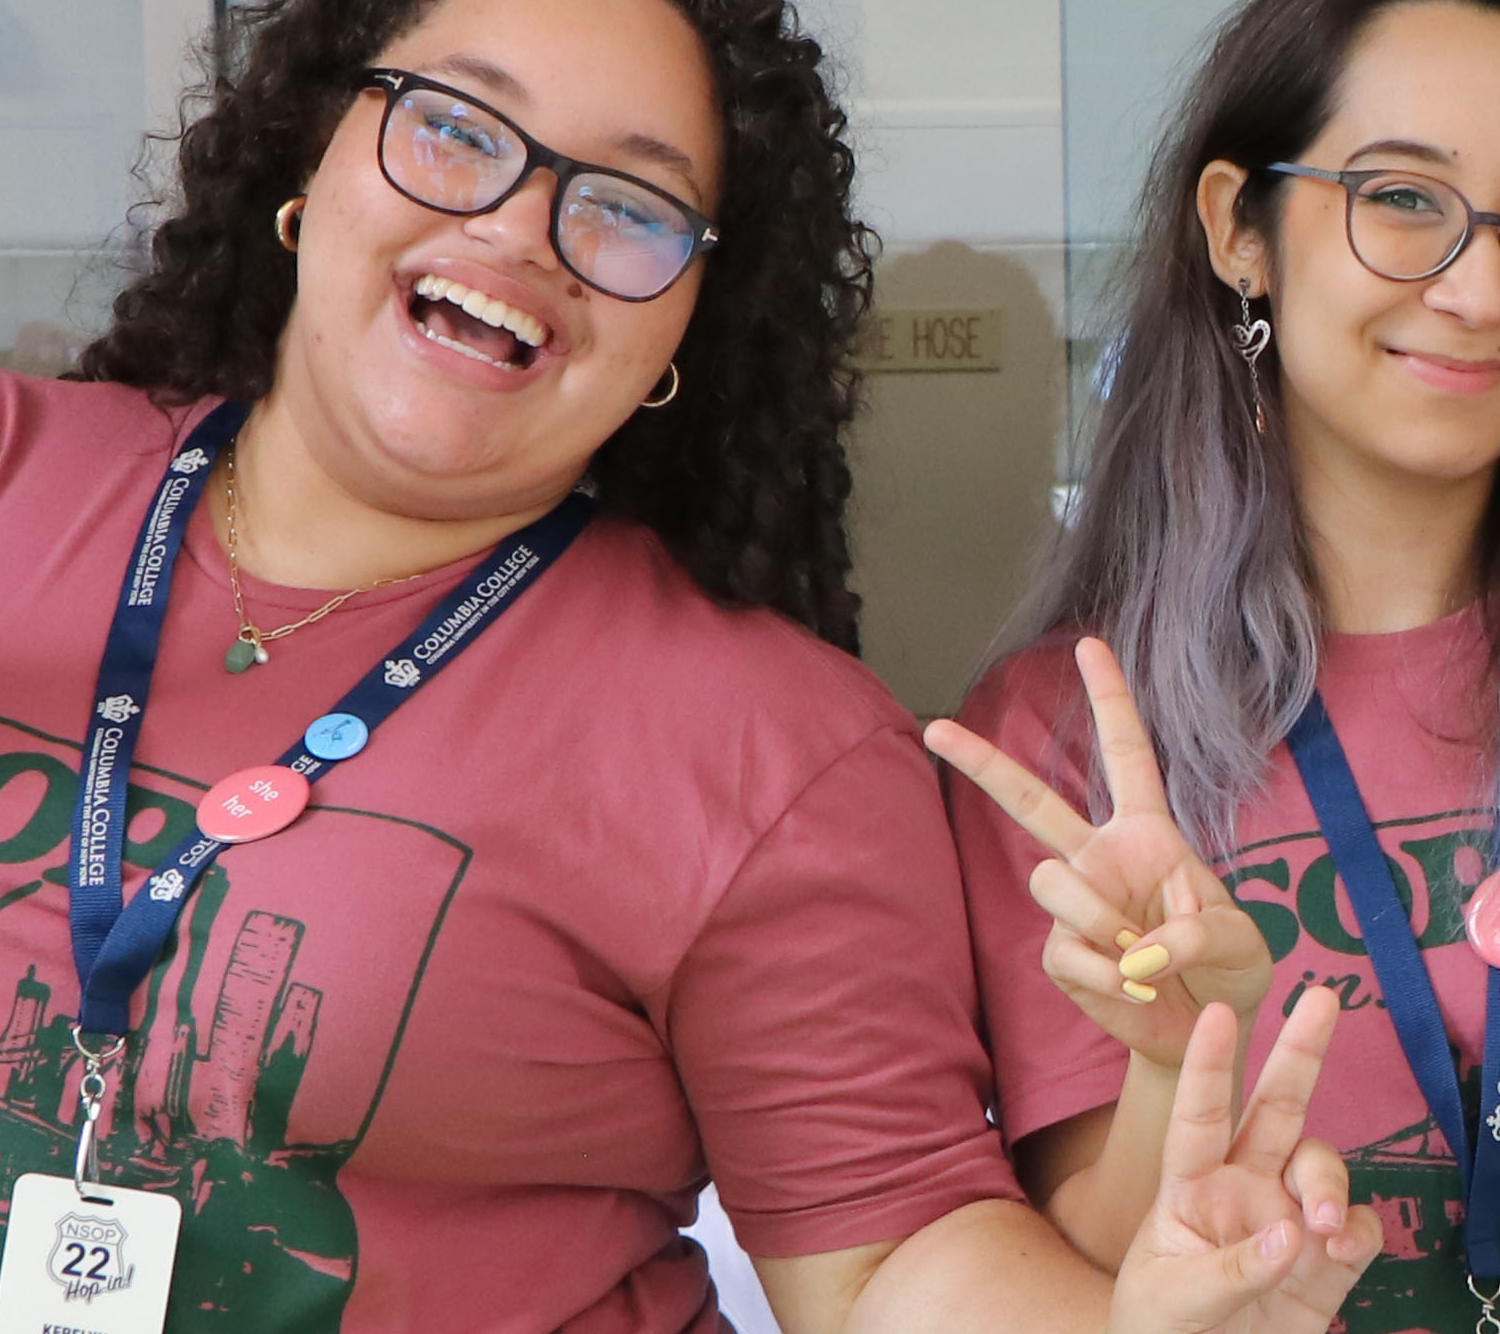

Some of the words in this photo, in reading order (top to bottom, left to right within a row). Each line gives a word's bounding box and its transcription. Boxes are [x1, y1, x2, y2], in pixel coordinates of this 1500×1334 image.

[911, 316, 981, 360] HOSE
[149, 477, 190, 546] COLUMBIA
[137, 544, 167, 606] COLLEGE
[414, 593, 484, 661] COLUMBIA
[476, 544, 533, 599] COLLEGE
[93, 726, 123, 808] COLUMBIA
[249, 778, 279, 802] she
[222, 795, 252, 820] her
[84, 807, 111, 886] COLLEGE
[1220, 828, 1500, 965] SOP
[1282, 970, 1390, 1019] in
[66, 1222, 117, 1242] NSOP
[61, 1243, 111, 1280] 22
[65, 1279, 101, 1303] Hop
